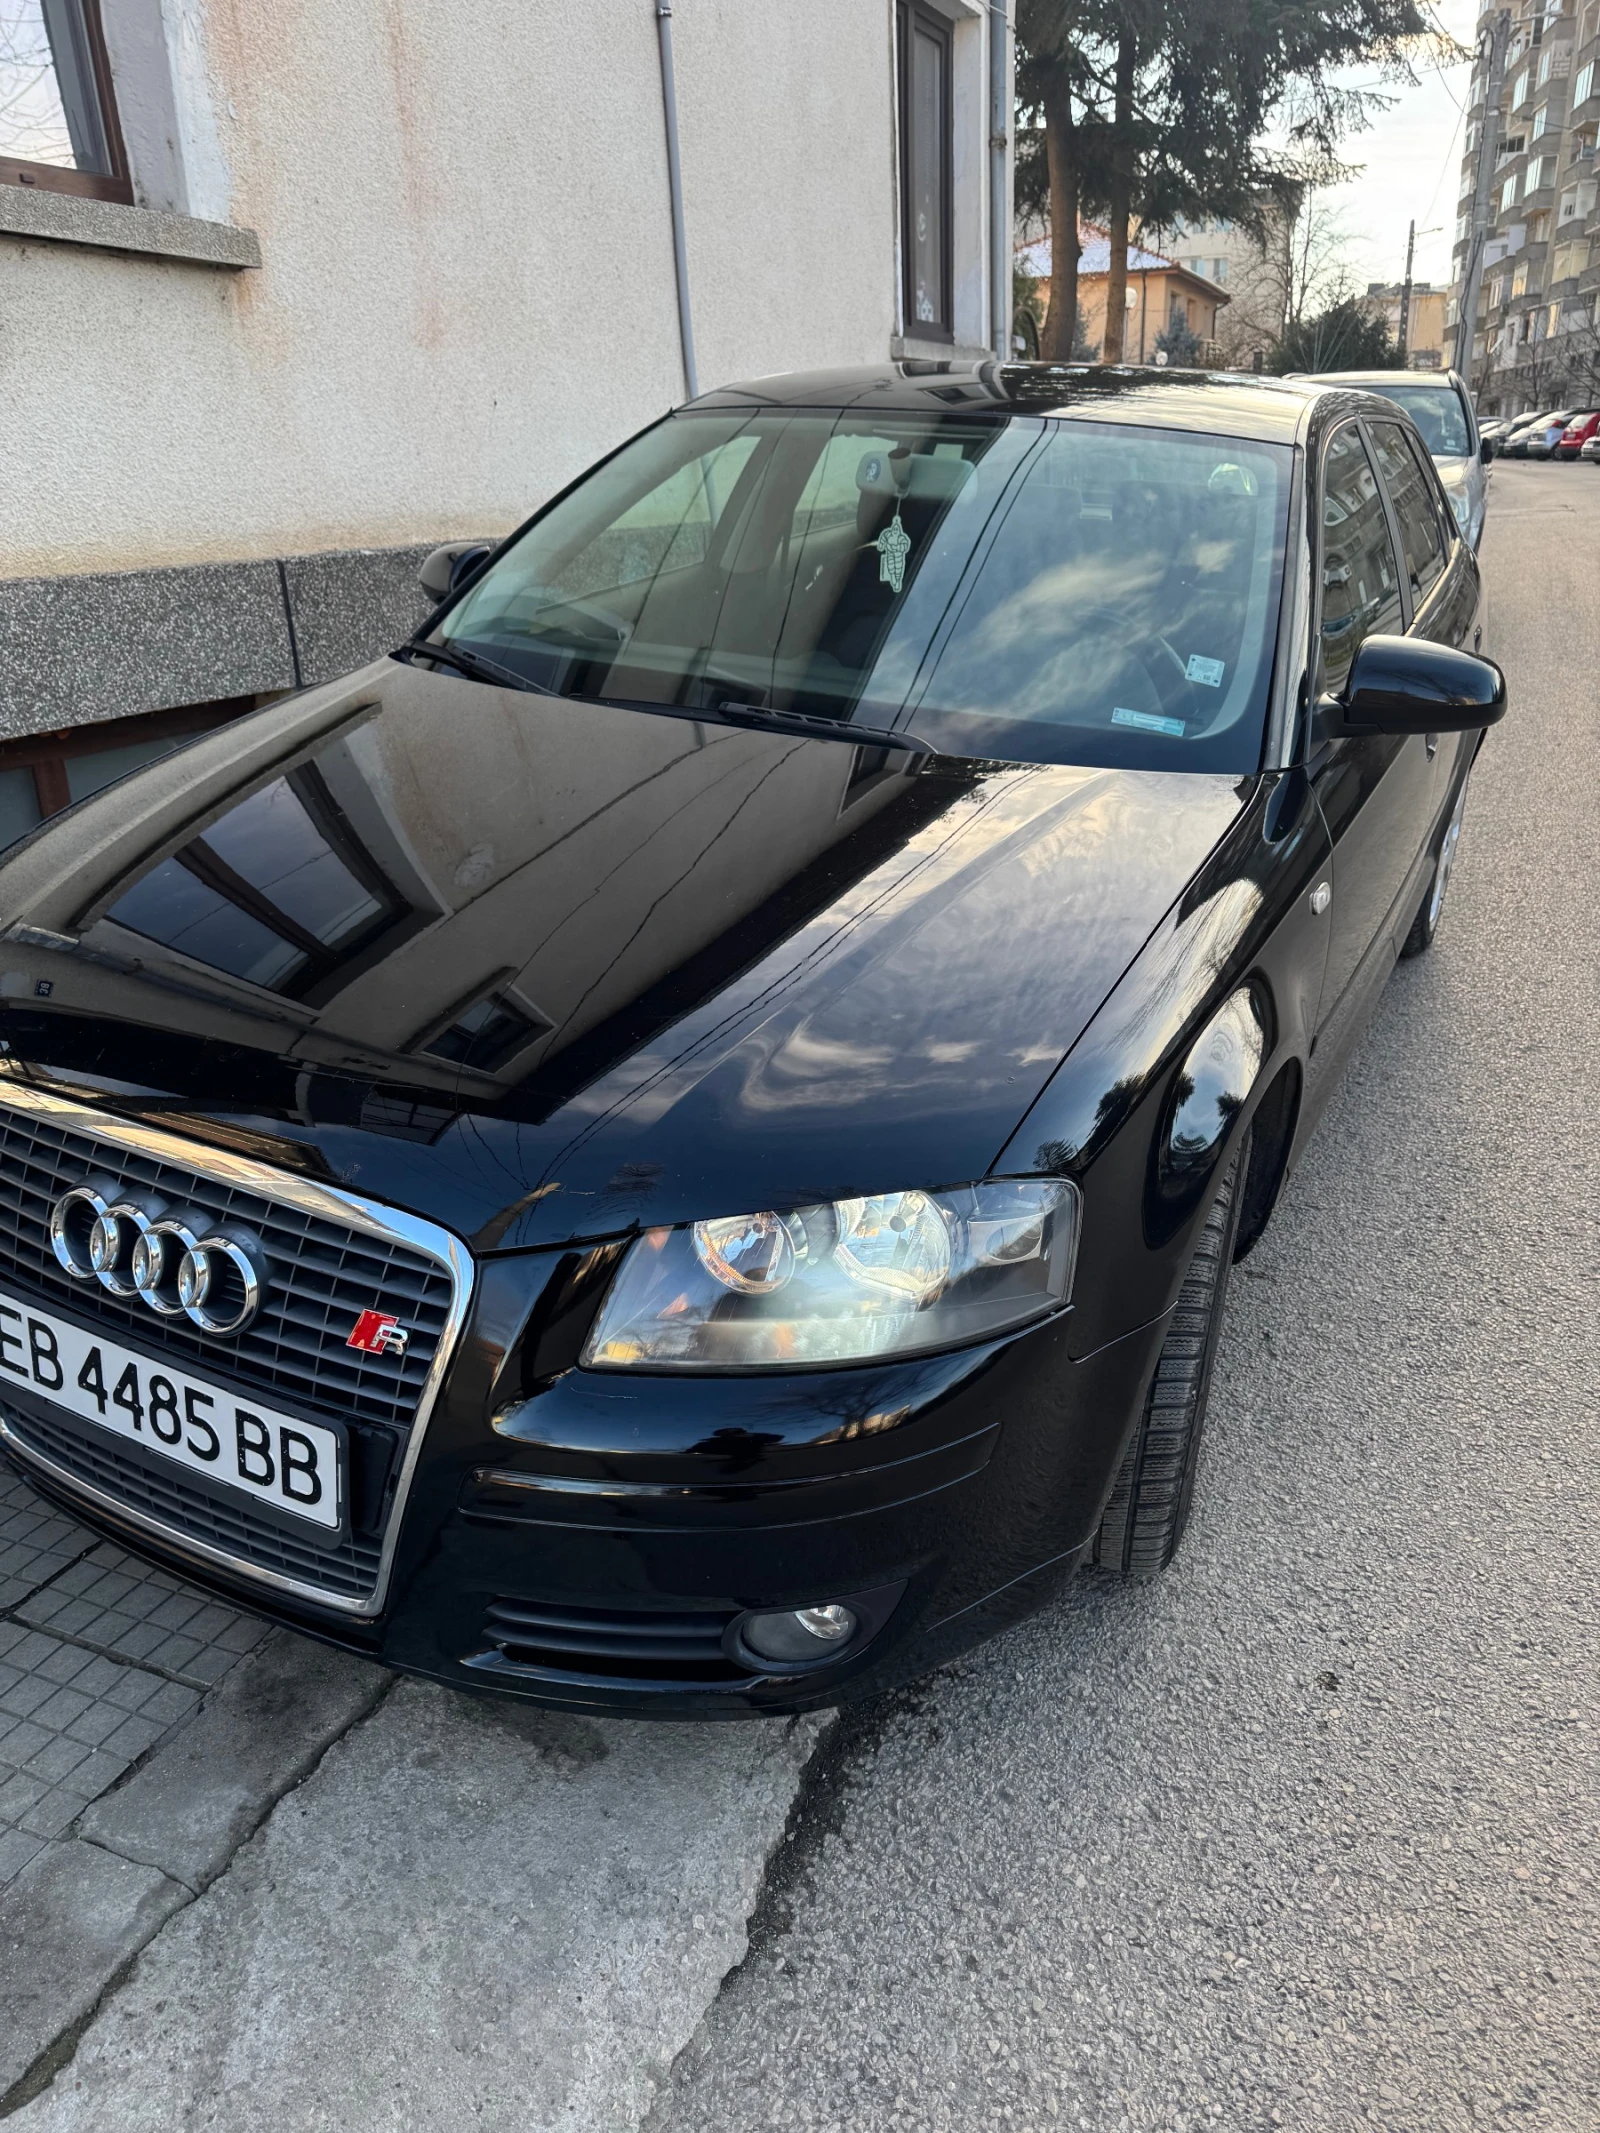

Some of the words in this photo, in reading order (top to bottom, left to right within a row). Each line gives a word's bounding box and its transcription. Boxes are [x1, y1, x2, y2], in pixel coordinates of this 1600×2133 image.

[0, 1304, 64, 1391] EB
[77, 1346, 220, 1461] 4485
[235, 1407, 322, 1505] BB
